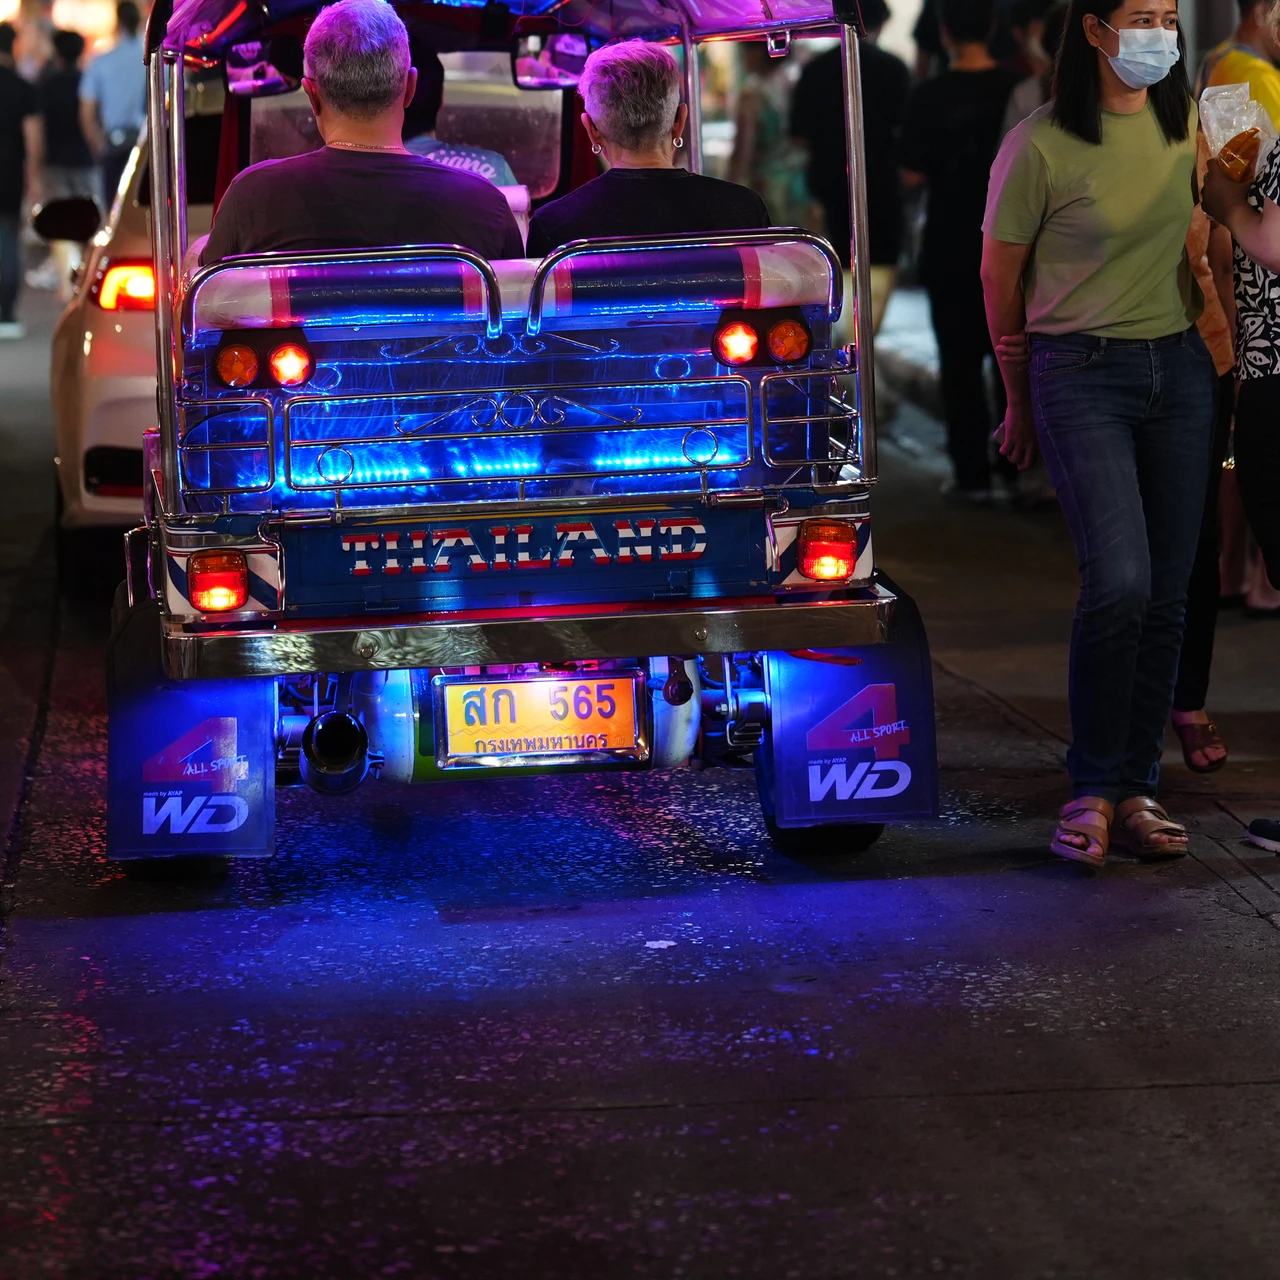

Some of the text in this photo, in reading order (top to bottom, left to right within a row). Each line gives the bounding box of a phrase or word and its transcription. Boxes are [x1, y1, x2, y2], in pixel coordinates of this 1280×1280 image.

[341, 516, 708, 577] THAILAND
[462, 683, 616, 727] สก 565
[807, 683, 910, 759] 4
[474, 733, 608, 754] กรงเทพมหานคร
[850, 720, 907, 743] ALL SPORT
[142, 717, 249, 793] 4
[182, 755, 247, 776] ALL SPORT
[808, 760, 912, 802] WD
[142, 796, 250, 835] WD
